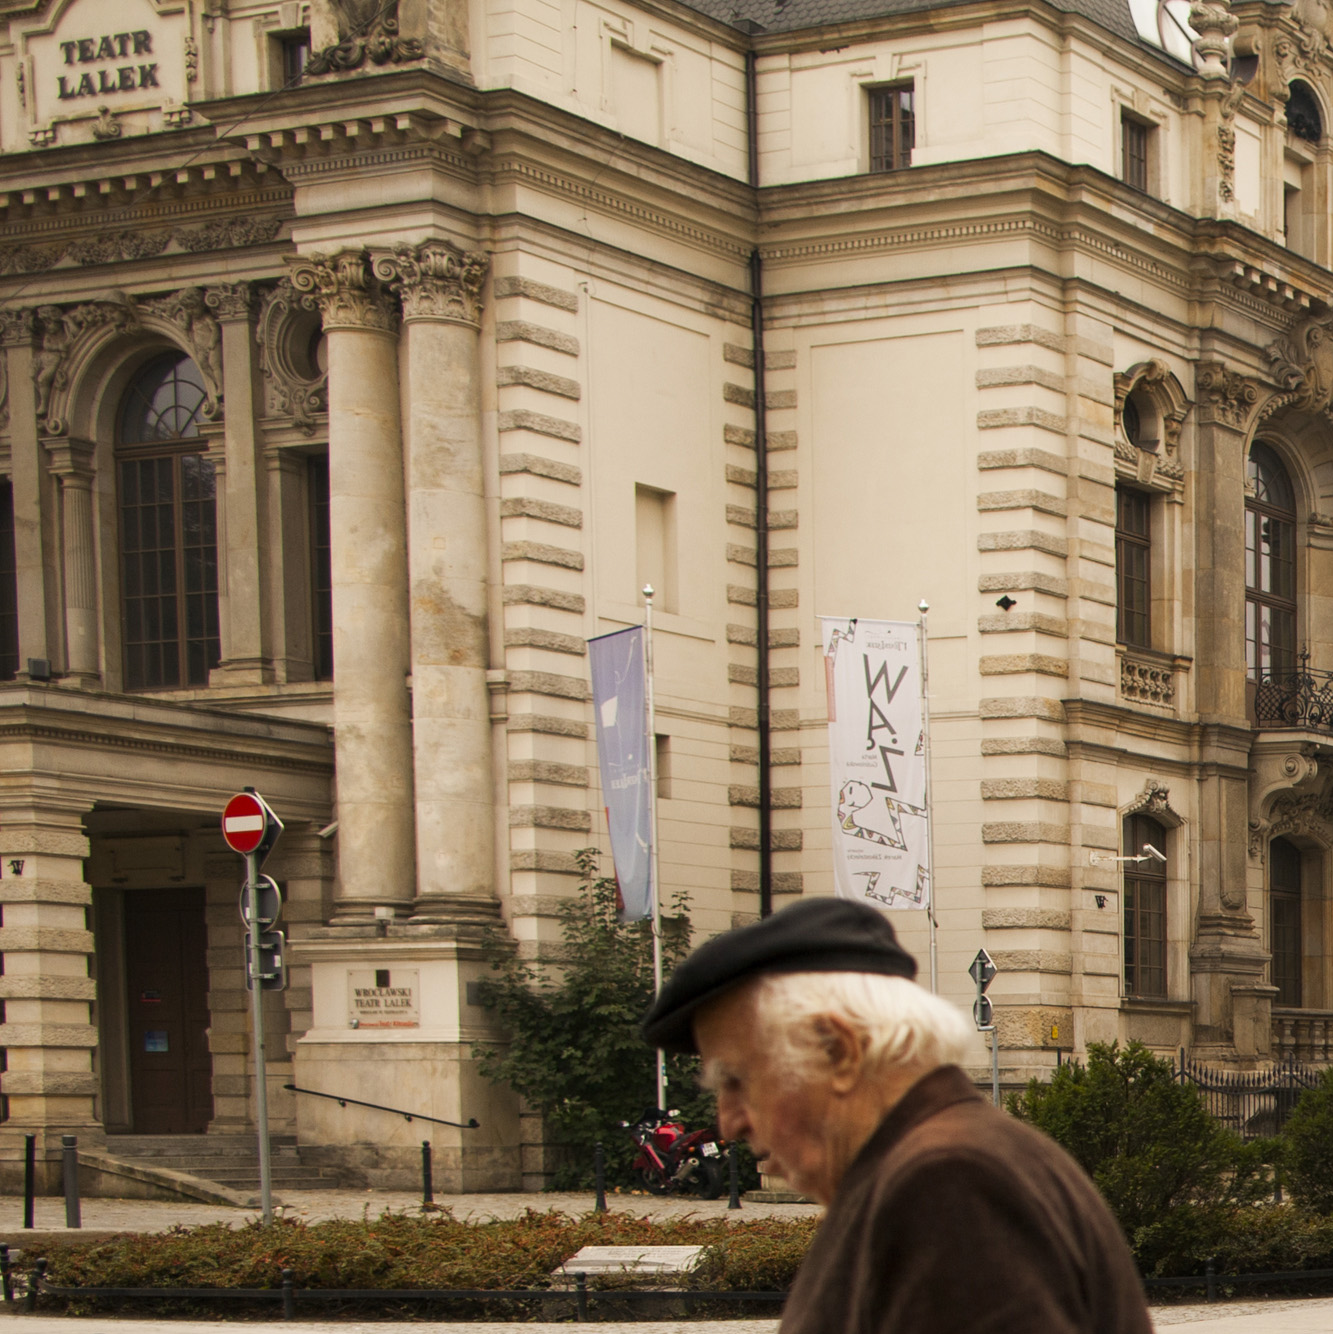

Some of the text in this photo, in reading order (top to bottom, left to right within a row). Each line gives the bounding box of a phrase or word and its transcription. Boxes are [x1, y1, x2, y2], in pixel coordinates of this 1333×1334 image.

[60, 30, 152, 64] TEATR
[57, 63, 159, 99] LALEK
[354, 999, 412, 1008] TEATR LALEK
